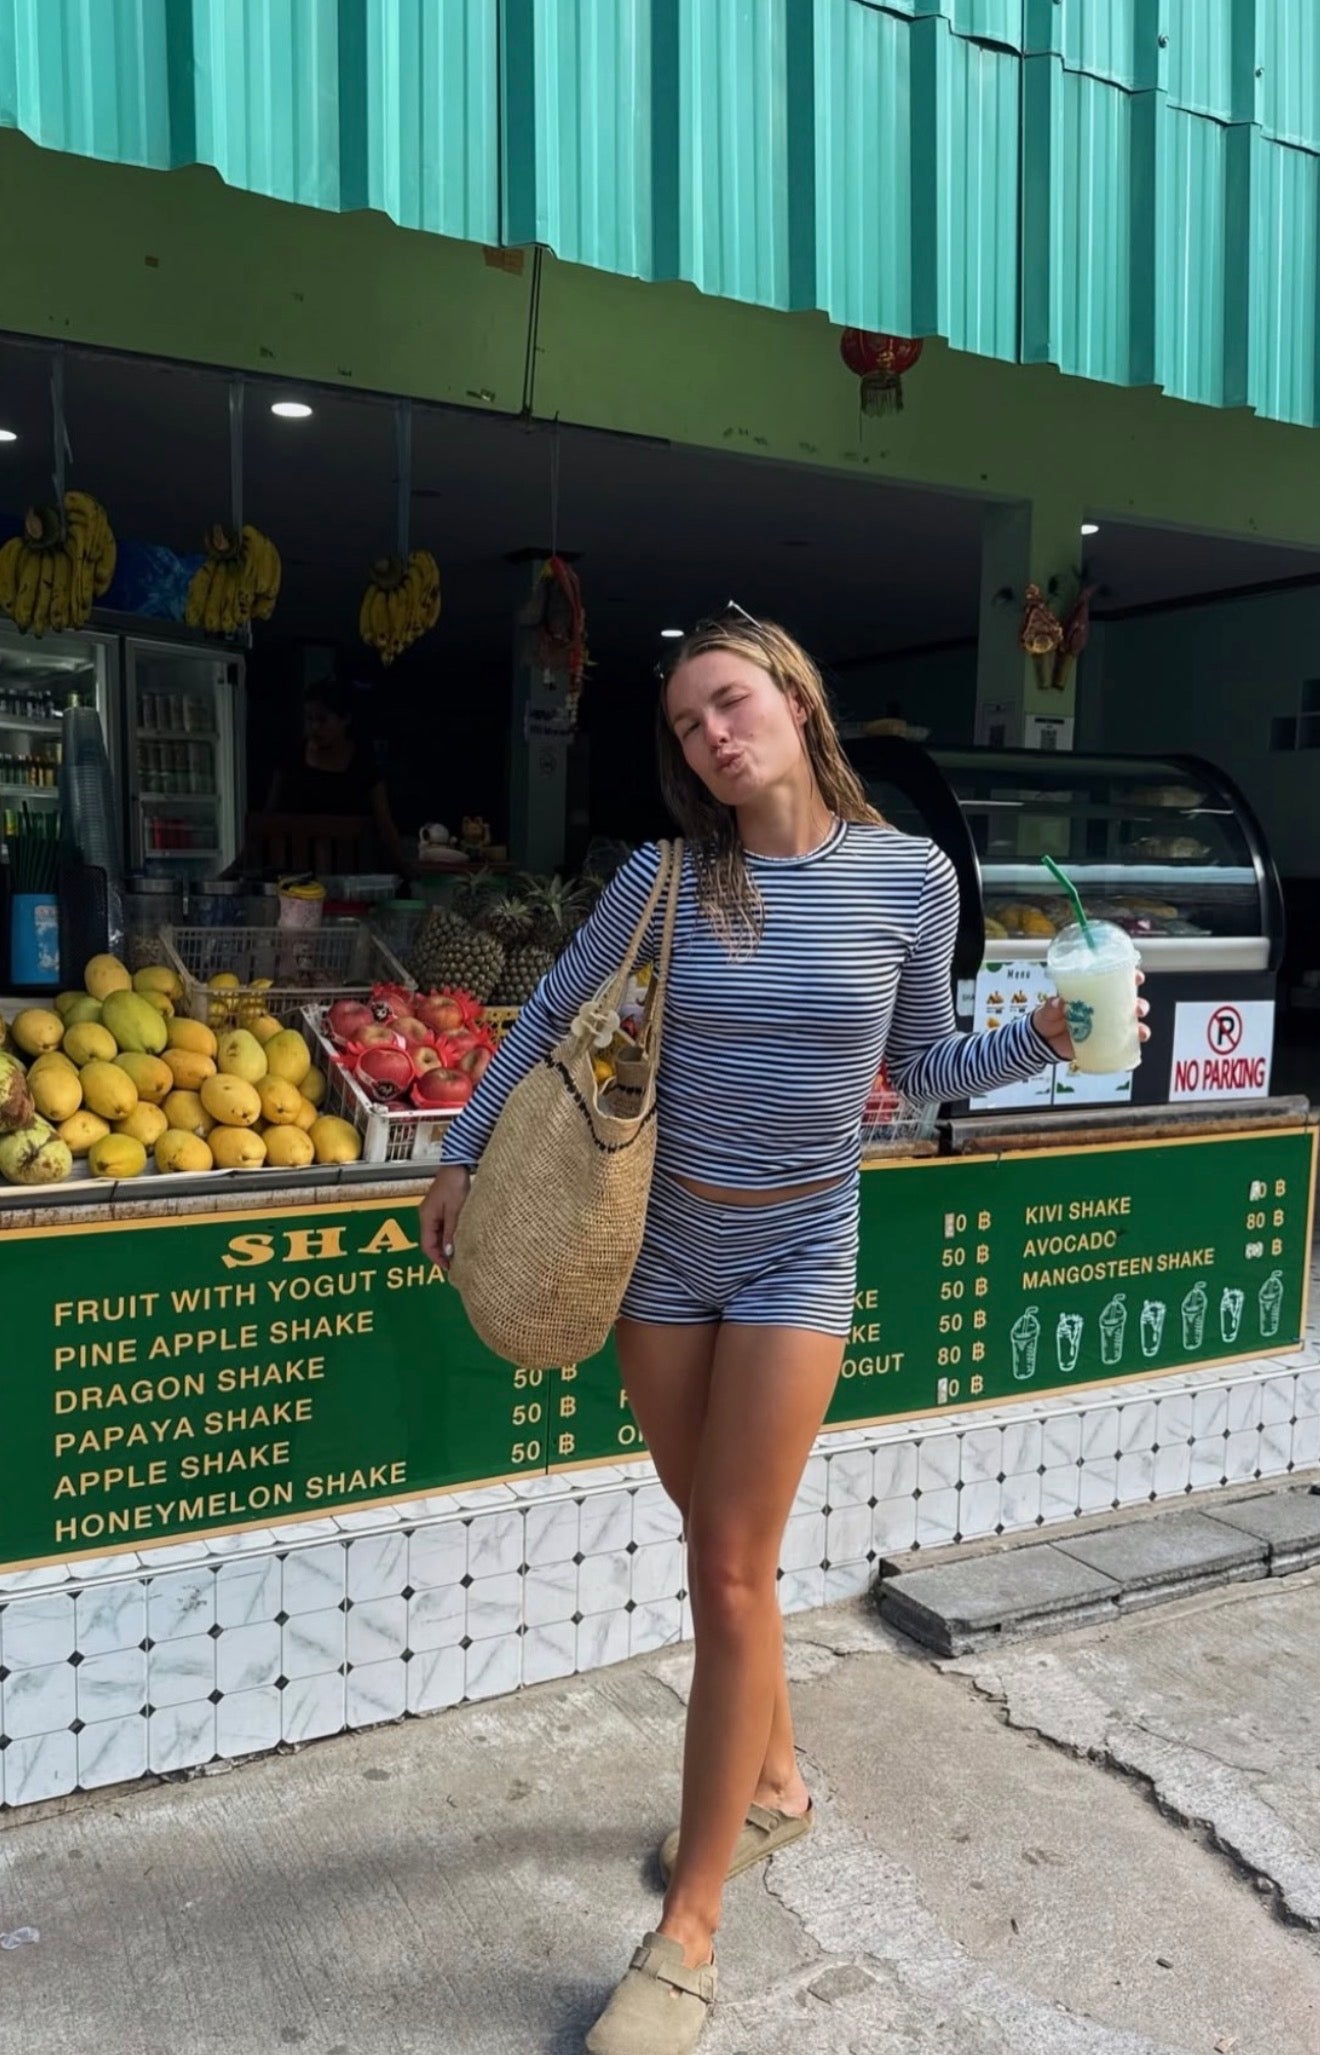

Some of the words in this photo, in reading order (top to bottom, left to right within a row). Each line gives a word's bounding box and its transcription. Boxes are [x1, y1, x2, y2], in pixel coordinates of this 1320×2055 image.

[1174, 1060, 1200, 1092] NO
[1202, 1057, 1266, 1091] PARKING
[1025, 1204, 1063, 1225] KIVI
[1068, 1196, 1131, 1220] SHAKE
[1246, 1211, 1266, 1230] 80
[221, 1217, 419, 1269] SHA
[942, 1247, 966, 1267] 50
[1023, 1230, 1117, 1258] AVOCADO
[1022, 1256, 1153, 1290] MANGOSTEEN
[1156, 1247, 1214, 1272] SHAKE
[54, 1293, 160, 1327] FRUIT
[170, 1283, 256, 1313] WITH
[267, 1270, 377, 1302] YOGUT
[386, 1264, 445, 1289] SHA
[940, 1280, 964, 1300] 50
[939, 1313, 963, 1333] 50
[55, 1339, 137, 1371] PINE
[148, 1324, 258, 1360] APPLE
[269, 1310, 374, 1344] SHAKE
[513, 1368, 543, 1389] 50
[841, 1353, 905, 1379] OGUT
[937, 1345, 961, 1366] 80
[55, 1372, 205, 1415] DRAGON
[217, 1356, 325, 1392] SHAKE
[55, 1416, 195, 1457] PAPAYA
[204, 1398, 312, 1435] SHAKE
[512, 1402, 542, 1426] 50
[511, 1440, 541, 1464] 50
[53, 1460, 167, 1500] APPLE
[180, 1441, 290, 1479] SHAKE
[54, 1482, 293, 1543] HONEYMELON
[305, 1461, 406, 1499] SHAKE
